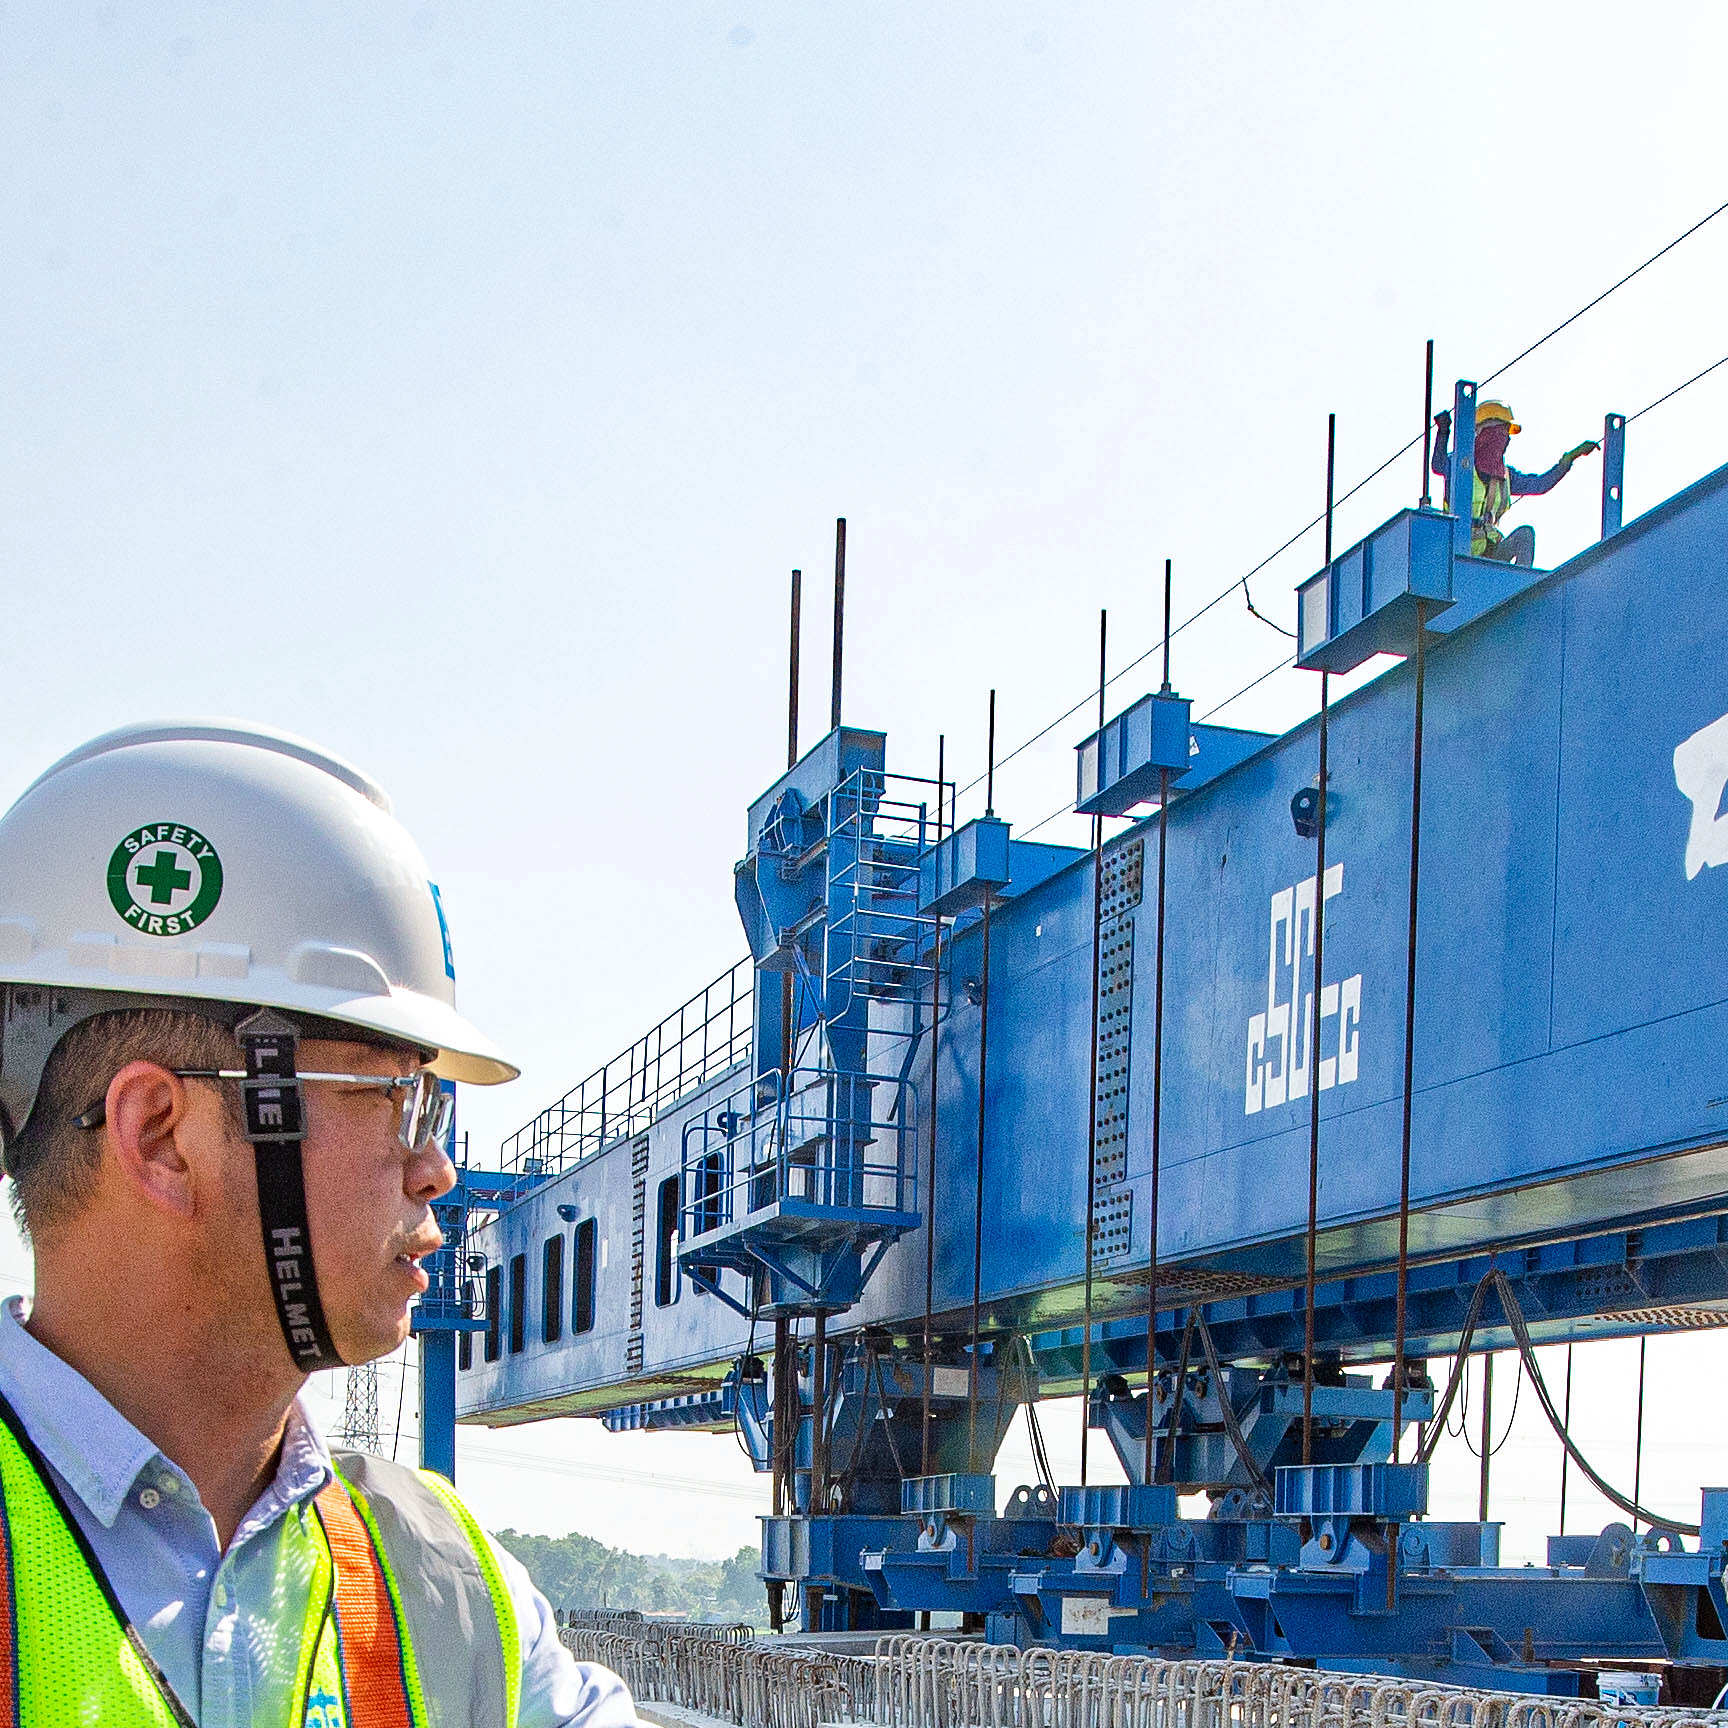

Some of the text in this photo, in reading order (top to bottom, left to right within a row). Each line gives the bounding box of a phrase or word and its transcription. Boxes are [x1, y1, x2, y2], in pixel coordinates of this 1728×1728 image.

[123, 824, 216, 862] SAFETY
[122, 901, 199, 937] FIRST
[271, 1226, 323, 1358] HELMET
